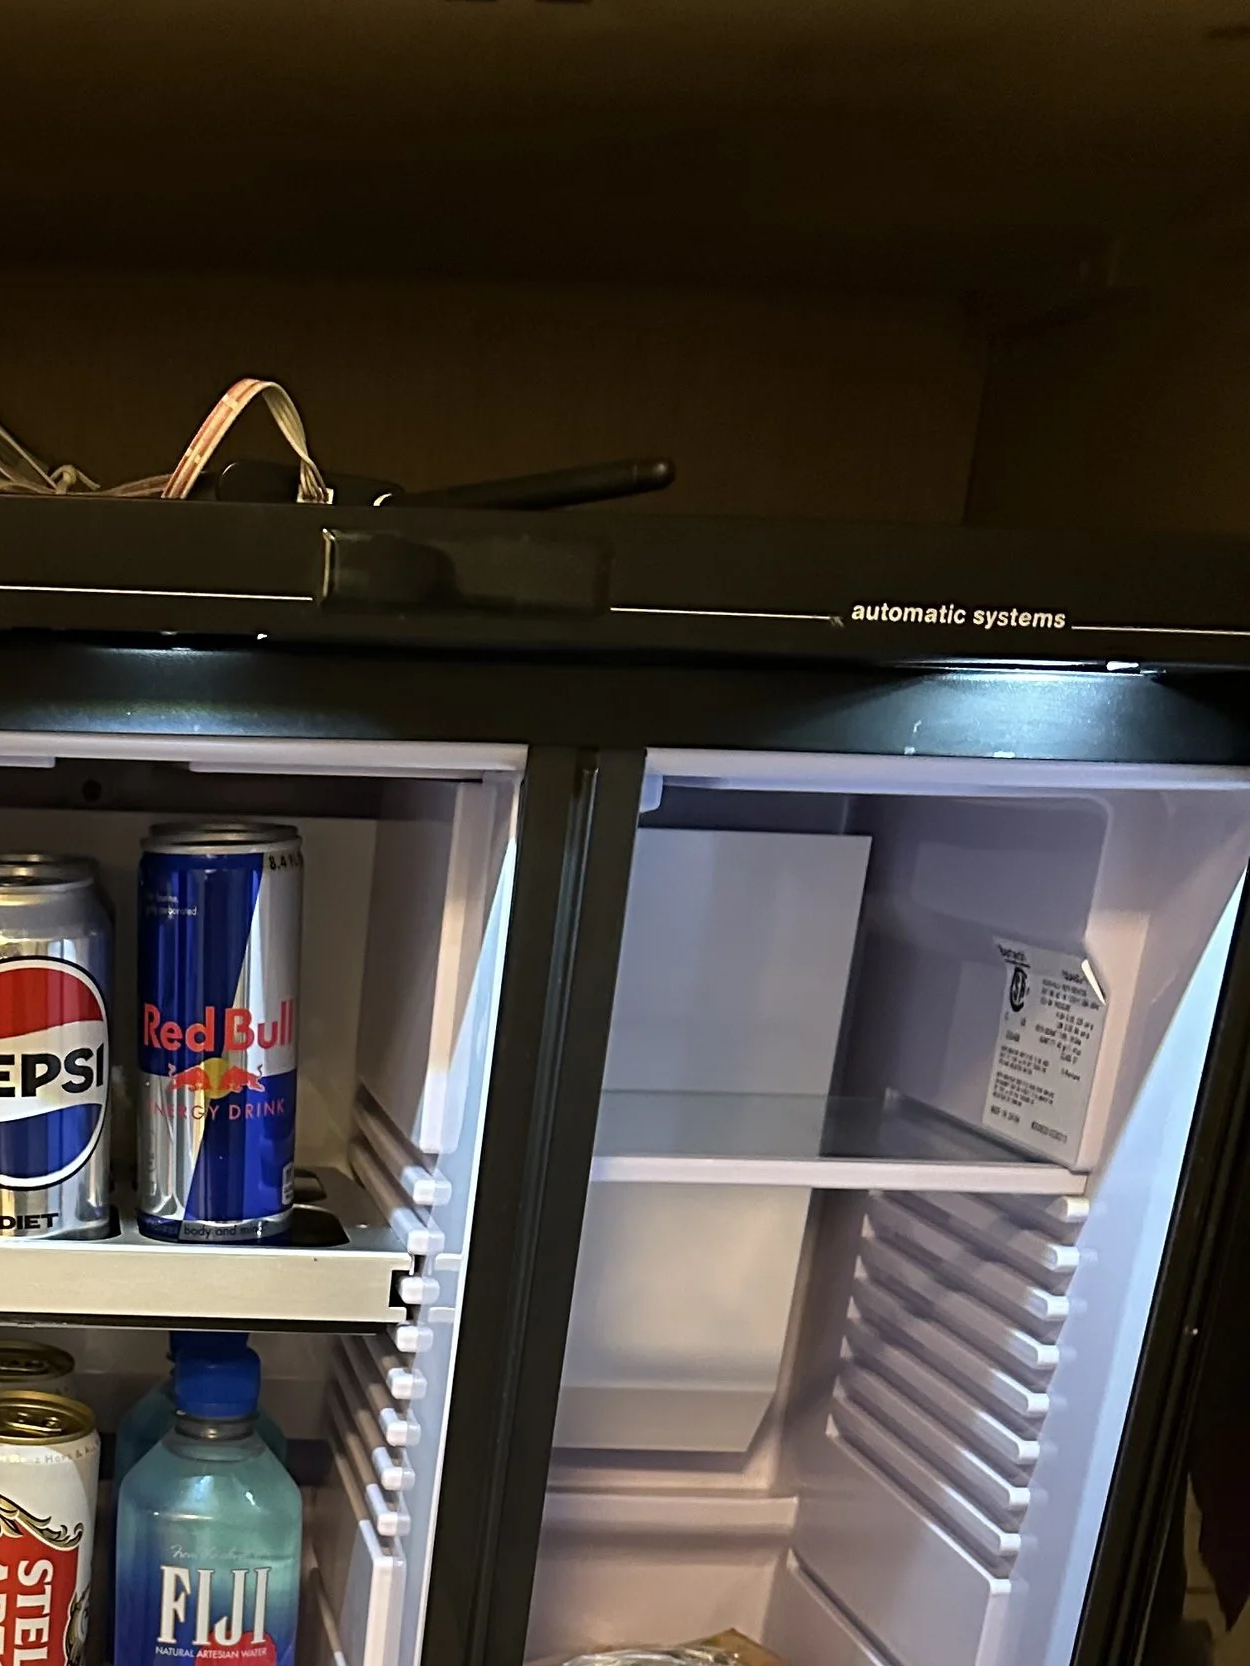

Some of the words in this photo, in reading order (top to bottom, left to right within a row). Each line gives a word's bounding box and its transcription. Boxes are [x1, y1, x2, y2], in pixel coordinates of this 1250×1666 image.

[851, 601, 967, 626] automatic
[972, 606, 1067, 631] systems
[143, 1002, 216, 1052] Red
[224, 1000, 294, 1050] Bull
[146, 1102, 220, 1121] ENERGY
[228, 1099, 287, 1121] DRINK
[184, 1225, 212, 1239] body
[215, 1225, 237, 1236] and
[156, 1565, 271, 1646] FIJI
[155, 1646, 195, 1658] NATURAL
[196, 1648, 240, 1659] ARTESIAN
[240, 1647, 267, 1658] WATER
